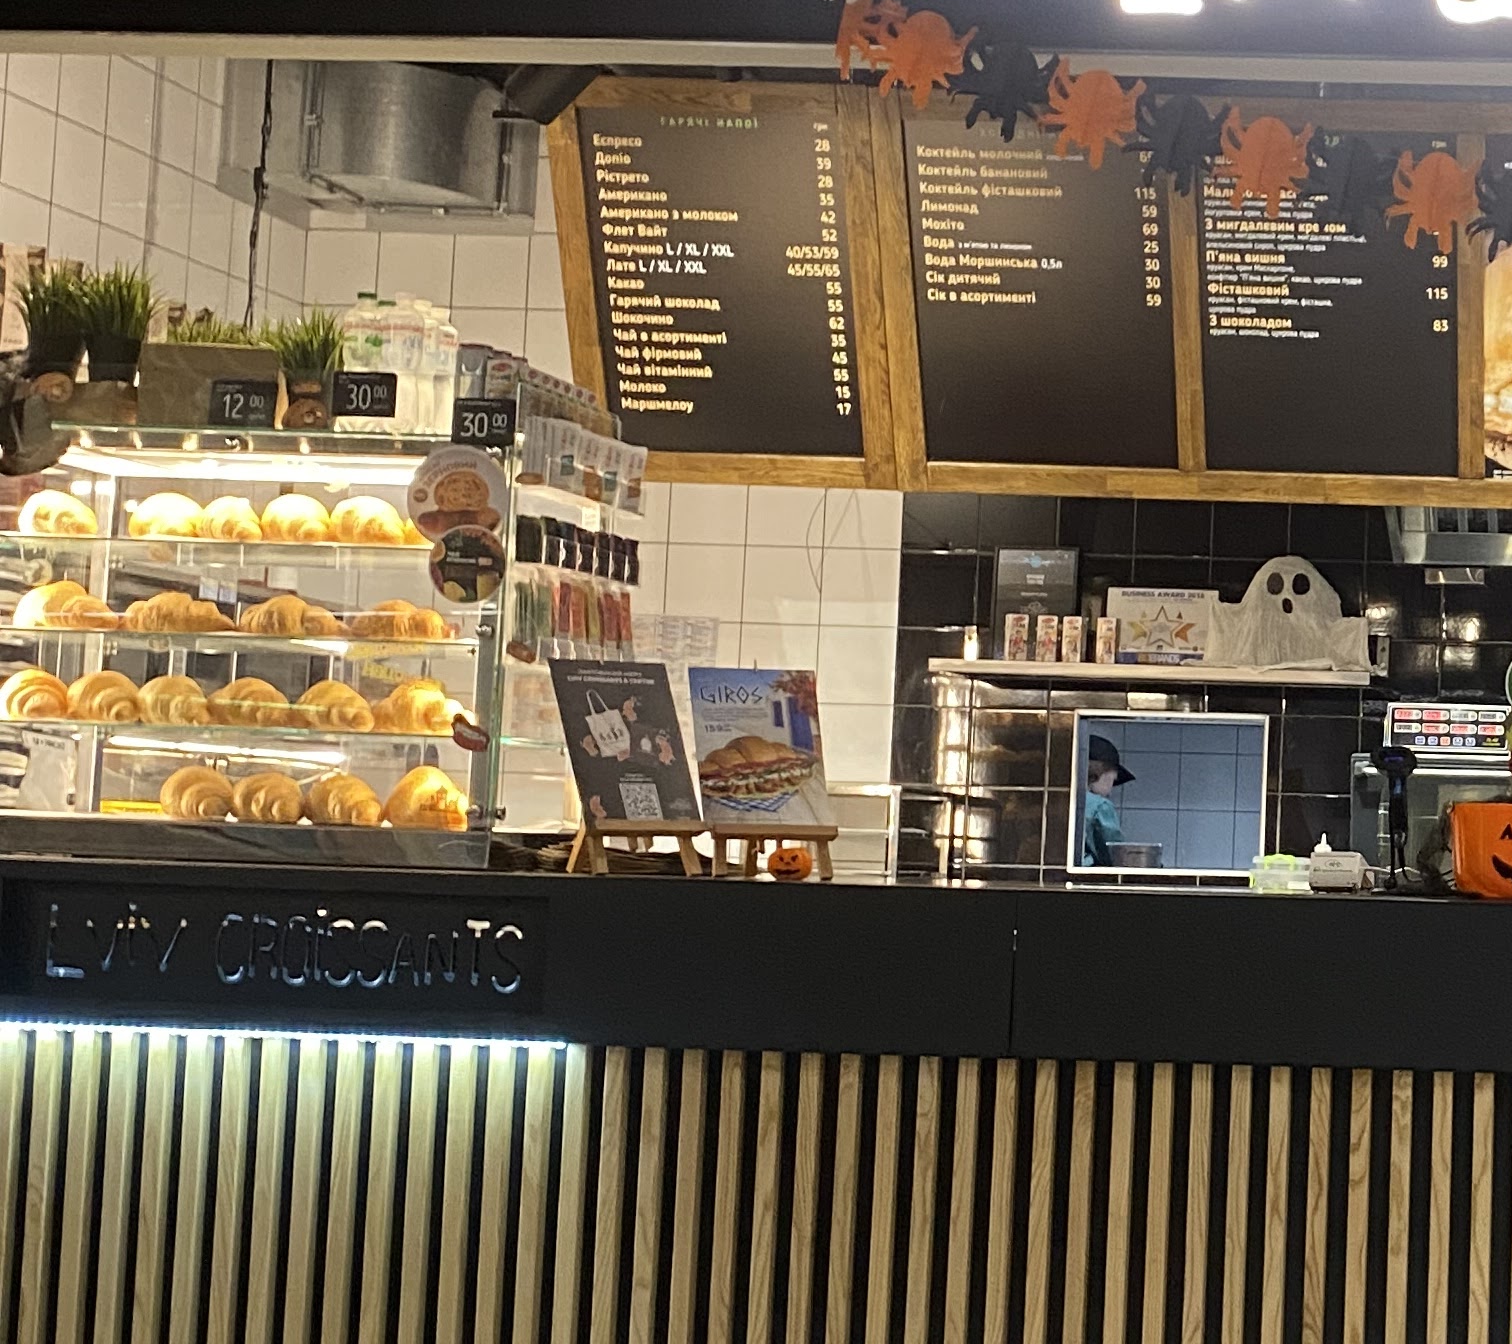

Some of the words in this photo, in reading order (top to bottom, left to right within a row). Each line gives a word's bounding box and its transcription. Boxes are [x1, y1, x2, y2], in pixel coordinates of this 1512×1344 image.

[660, 116, 710, 128] ГАРЯЧІ
[716, 118, 759, 129] НАПОЇ
[592, 134, 642, 148] Еспресо
[814, 140, 830, 152] 28
[595, 151, 631, 166] Допіо
[816, 158, 831, 170] 39
[916, 146, 975, 159] Коктейль
[980, 149, 1042, 161] молочний
[596, 170, 649, 184] Рістрето
[818, 176, 833, 188] 28
[918, 164, 977, 177] Коктейль
[980, 166, 1047, 179] банановий
[598, 188, 668, 203] Американо
[819, 194, 834, 206] 35
[920, 182, 978, 195] Коктейль
[981, 184, 1062, 198] фісташковий
[1134, 187, 1156, 200] 115
[600, 206, 668, 221] Американо
[672, 210, 679, 220] з
[682, 210, 738, 222] молоком
[820, 212, 836, 224] 42
[921, 200, 979, 214] Лимонад
[1142, 206, 1157, 217] 59
[602, 224, 635, 238] Флет
[638, 225, 668, 238] Вайт
[822, 229, 837, 242] 52
[922, 218, 965, 231] Мохіто
[1143, 223, 1158, 236] 69
[1205, 219, 1213, 230] З
[1217, 221, 1294, 233] мигдалевим
[604, 242, 664, 256] Капучино
[666, 243, 674, 255] L
[685, 244, 700, 256] XL
[712, 244, 734, 257] XXL
[786, 246, 839, 260] 40/53/59
[924, 236, 954, 248] Вода
[1144, 241, 1159, 253] 25
[606, 259, 636, 272] Лате
[639, 260, 646, 272] L
[658, 260, 672, 273] XL
[684, 261, 706, 274] XXL
[788, 263, 840, 277] 45/55/65
[925, 253, 955, 266] Вода
[959, 255, 1037, 269] Моршинська
[1041, 258, 1062, 269] 0,5л
[1145, 259, 1160, 271] 30
[1206, 250, 1241, 263] П'яна
[1245, 253, 1285, 263] вишня
[1432, 256, 1448, 268] 99
[608, 277, 644, 290] Какао
[826, 282, 842, 294] 55
[926, 271, 944, 283] Сік
[948, 273, 1000, 285] дитячий
[1145, 276, 1160, 288] 30
[927, 288, 946, 301] Сік
[950, 293, 956, 301] в
[960, 291, 1036, 304] асортименті
[1146, 294, 1161, 306] 59
[1208, 283, 1289, 296] Фісташковий
[1426, 288, 1448, 300] 115
[610, 294, 661, 308] Гарячий
[664, 298, 720, 311] шоколад
[828, 300, 843, 312] 55
[611, 312, 674, 326] Шокочино
[829, 318, 844, 330] 62
[1209, 315, 1217, 326] З
[1221, 317, 1291, 330] шоколадом
[1432, 320, 1448, 332] 83
[614, 328, 637, 342] Чай
[640, 332, 648, 341] в
[652, 330, 727, 345] асортименті
[831, 334, 846, 346] 35
[615, 345, 638, 359] Чай
[642, 347, 702, 362] фірмовий
[832, 352, 848, 364] 45
[618, 363, 640, 376] Чай
[644, 364, 712, 378] вітамінний
[834, 369, 849, 382] 55
[346, 384, 372, 410] 30
[374, 385, 387, 398] 00
[620, 380, 666, 393] Молоко
[836, 386, 850, 399] 15
[222, 394, 242, 418] 12
[250, 395, 264, 408] 00
[621, 398, 694, 414] Маршмелоу
[836, 403, 851, 416] 17
[460, 412, 488, 438] 30
[492, 414, 508, 428] 00
[700, 683, 763, 704] GIROS
